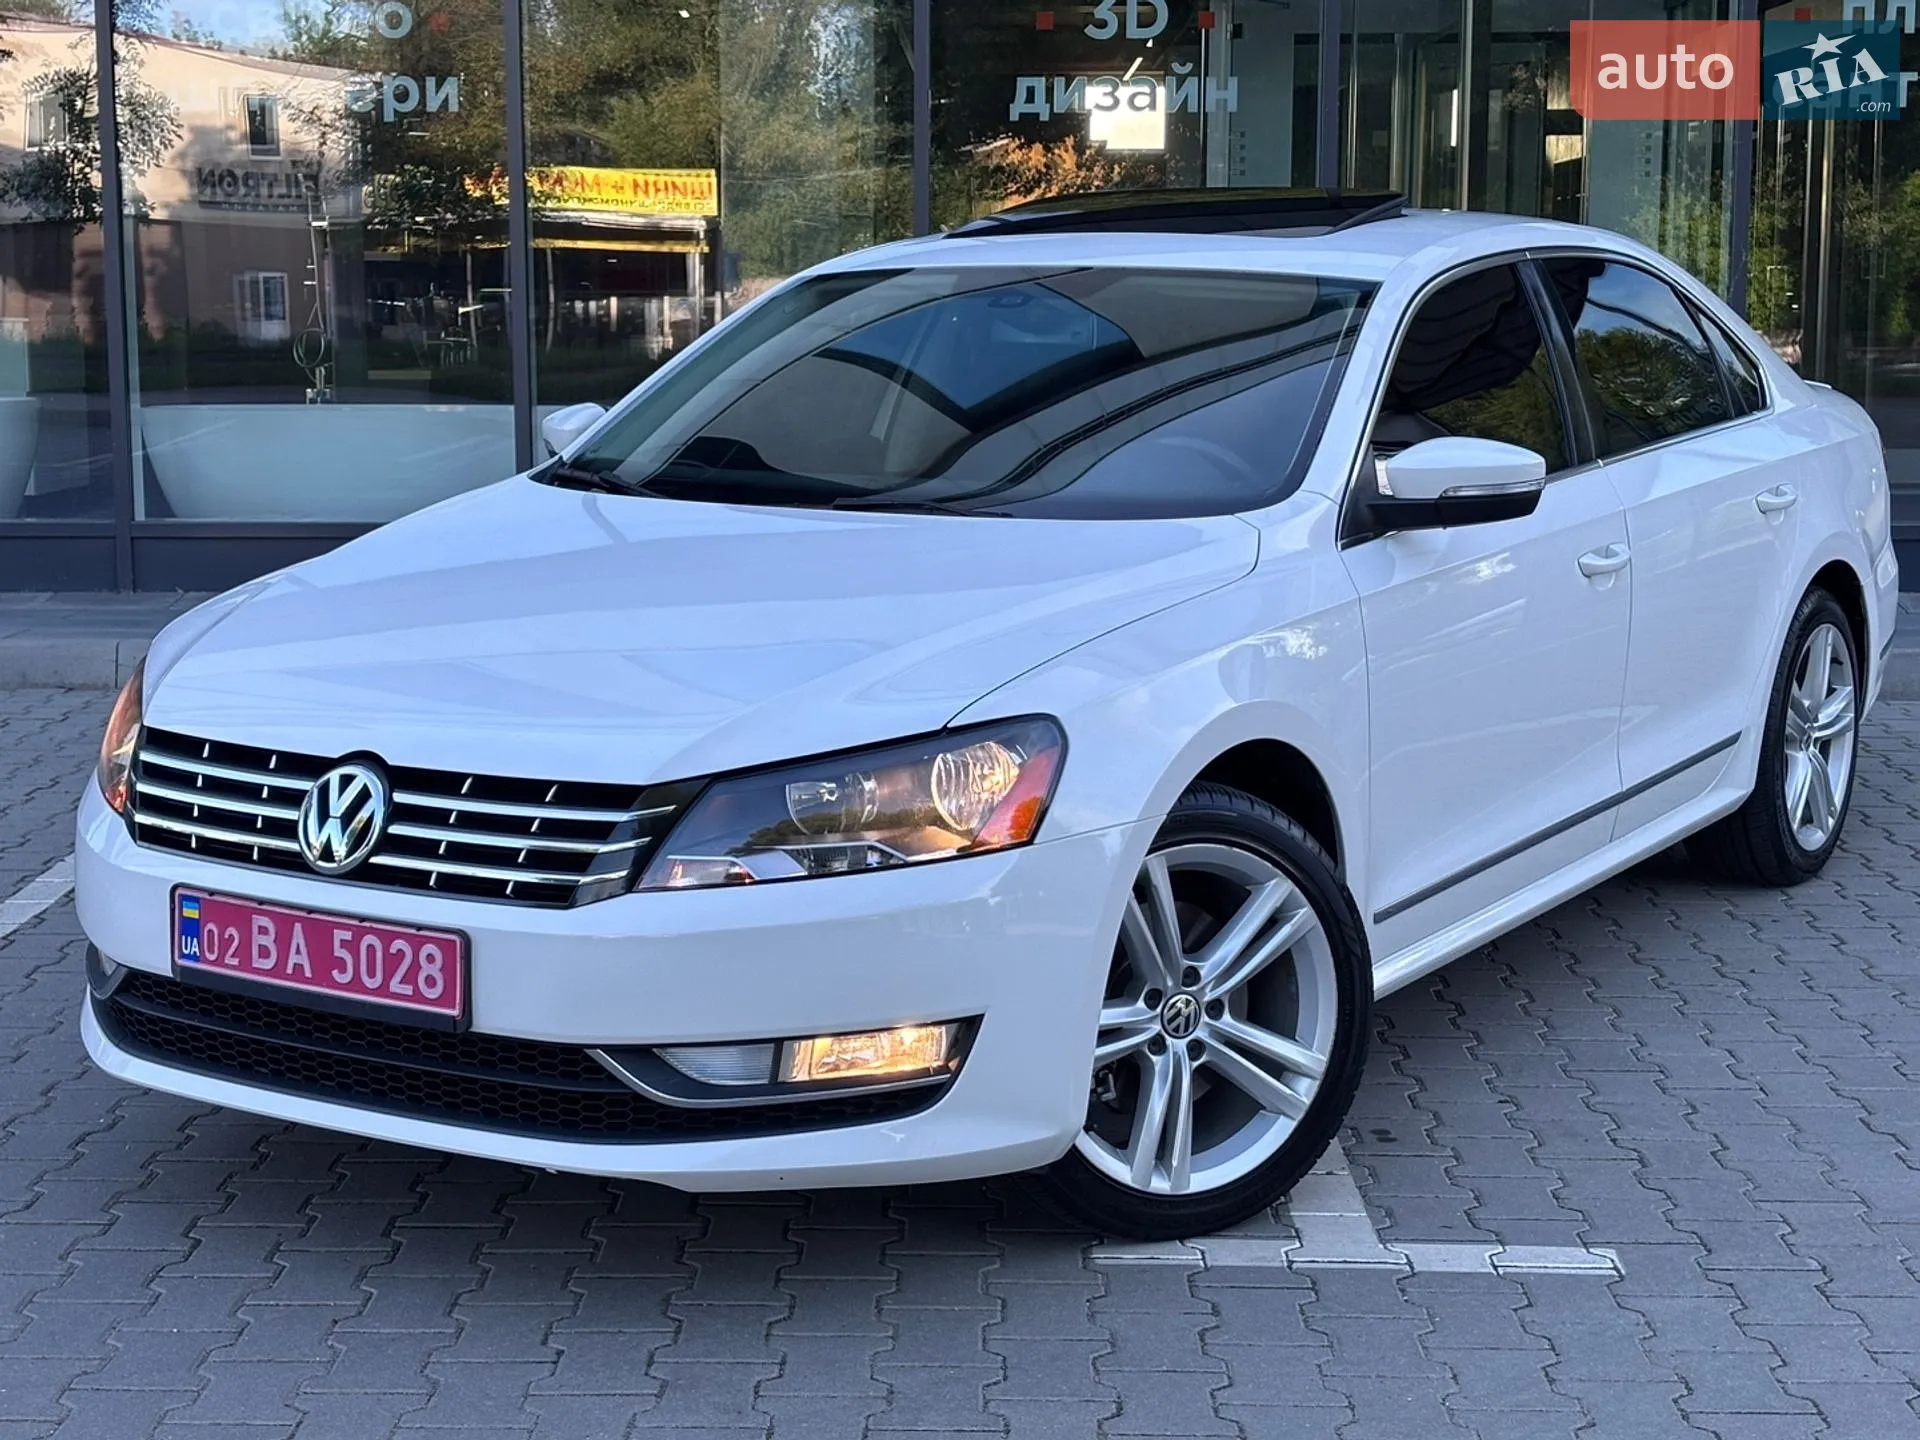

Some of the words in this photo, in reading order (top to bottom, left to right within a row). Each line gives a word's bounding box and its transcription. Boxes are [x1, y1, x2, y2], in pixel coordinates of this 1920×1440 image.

[1083, 0, 1170, 40] 3D
[1009, 62, 1238, 121] дизайн
[182, 935, 200, 957] UA
[203, 921, 241, 967] 02
[251, 914, 313, 979] BA
[331, 928, 445, 1000] 5028
